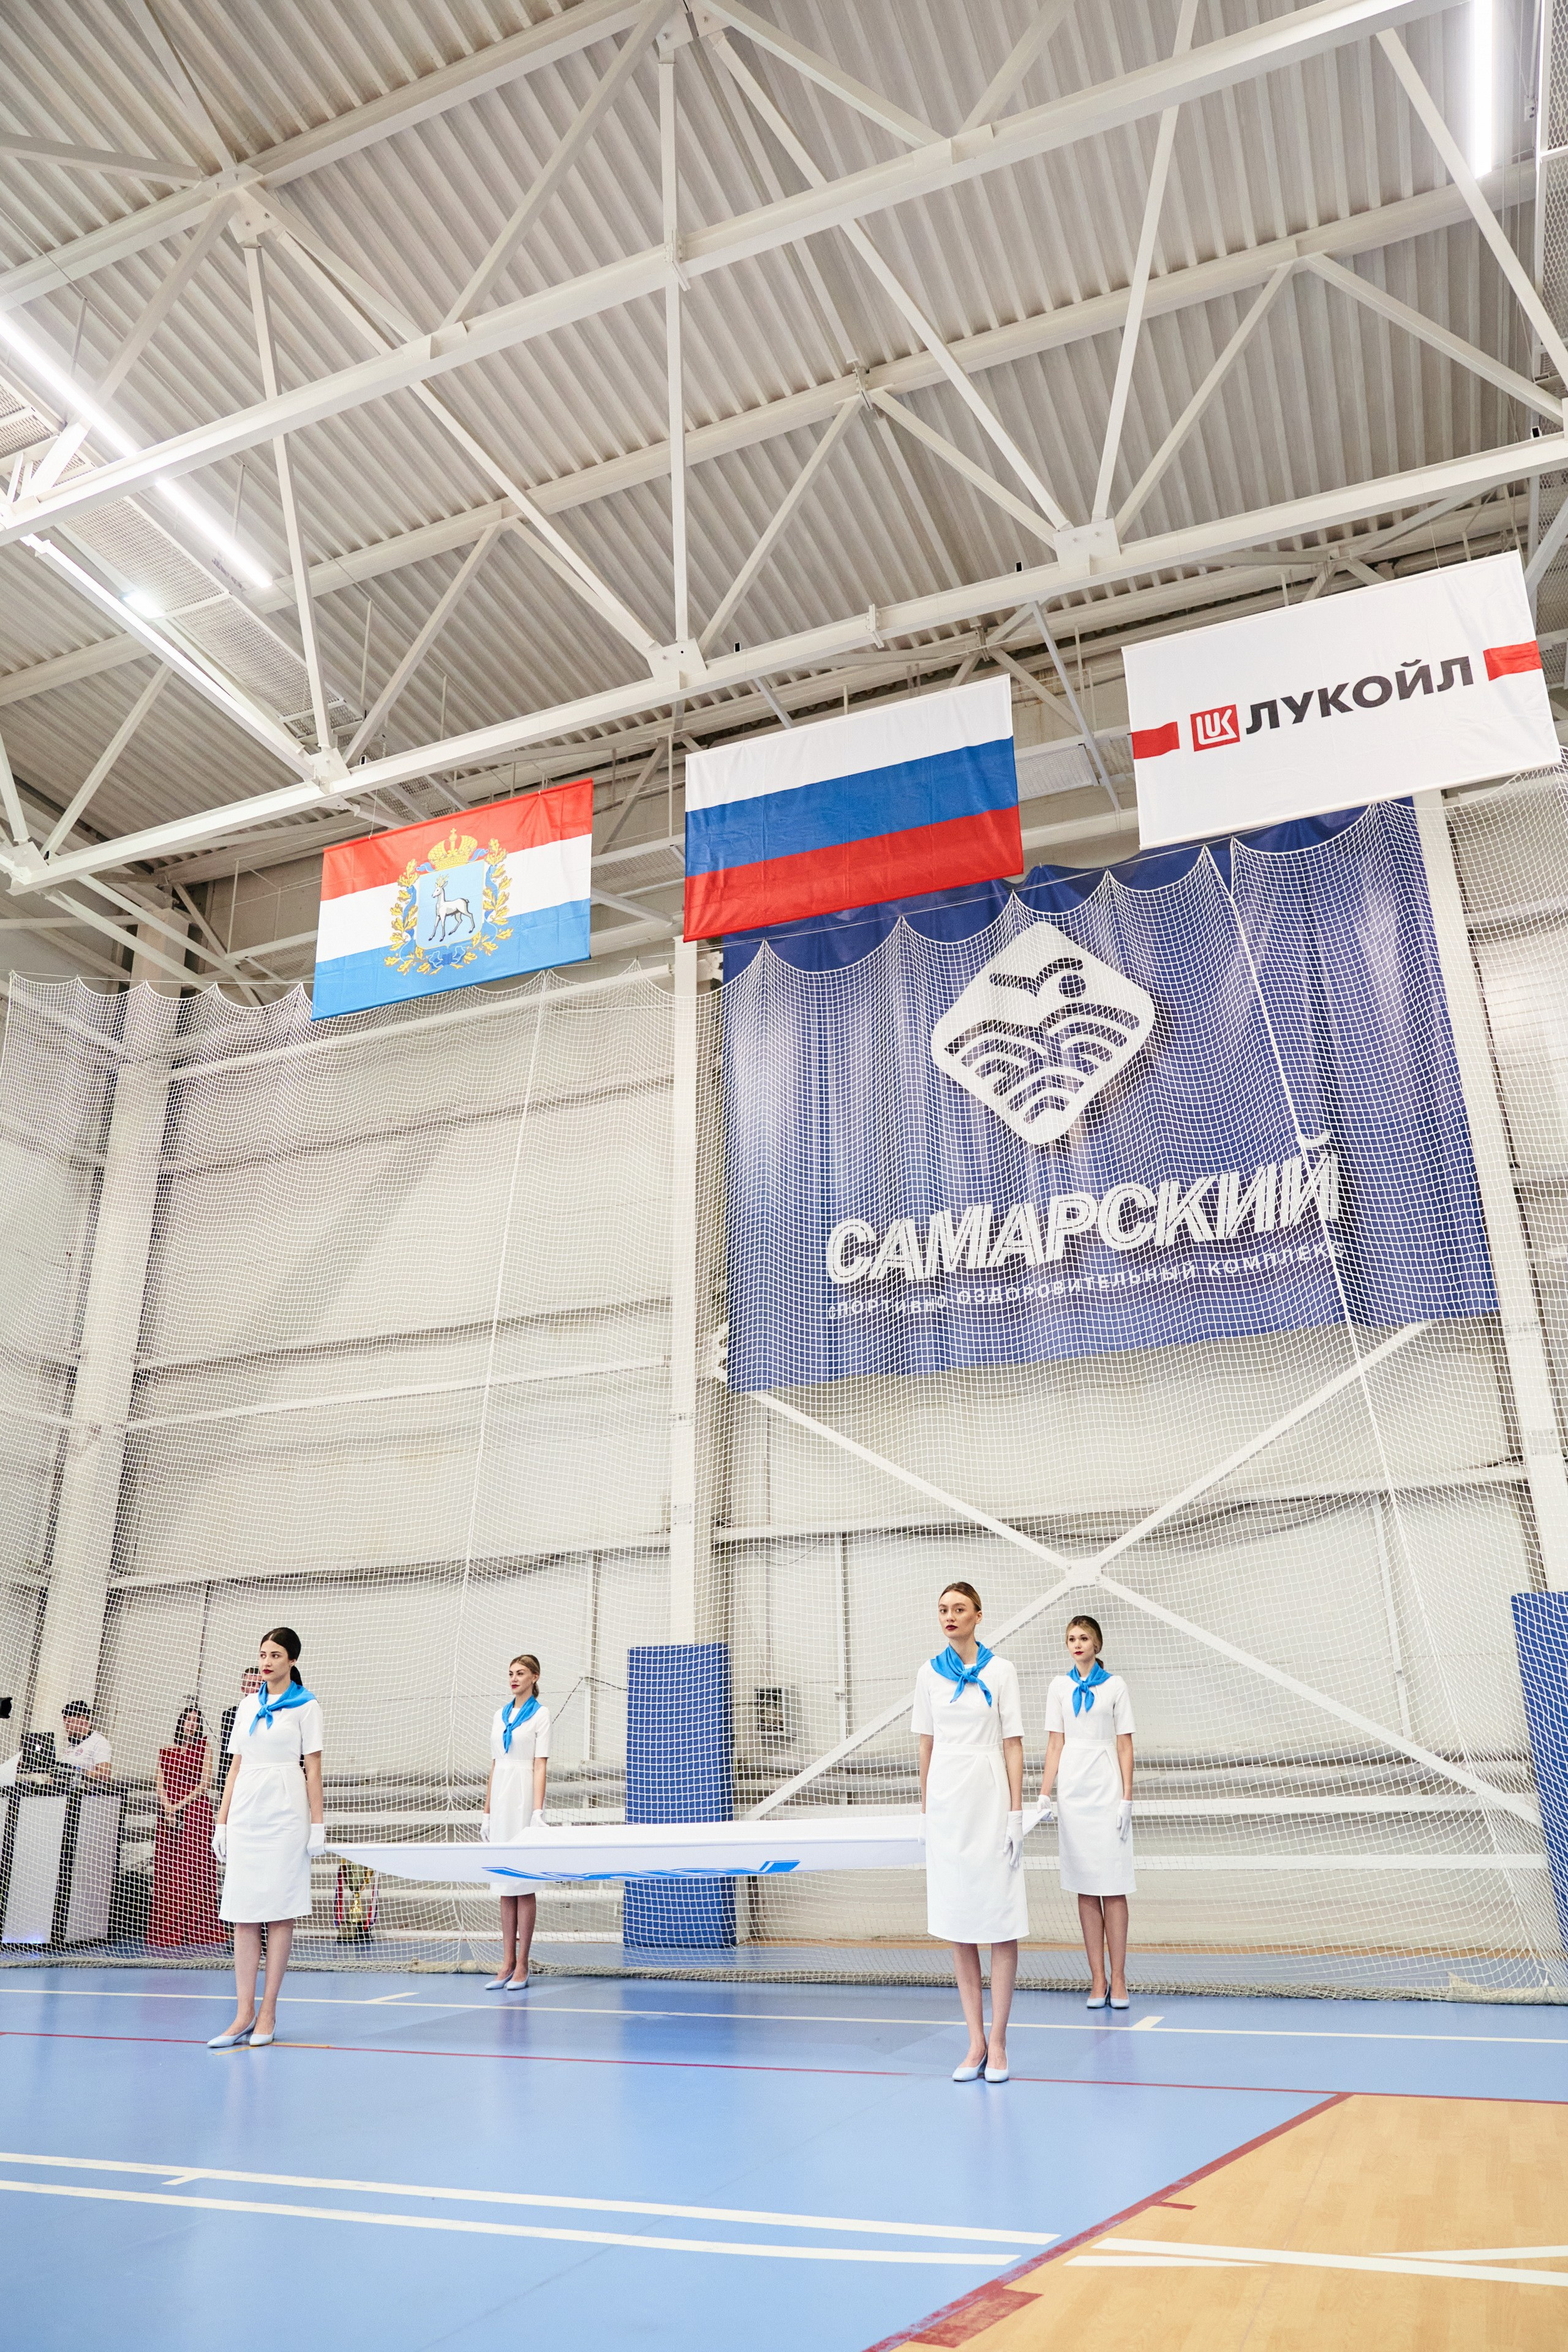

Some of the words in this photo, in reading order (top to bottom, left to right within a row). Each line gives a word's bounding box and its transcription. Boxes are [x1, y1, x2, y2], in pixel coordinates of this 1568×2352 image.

[1245, 655, 1474, 734] ЛУКОЙЛ
[826, 1131, 1340, 1284] САМАРСКИЙ
[1207, 1242, 1344, 1276] КОМПЛЕКС
